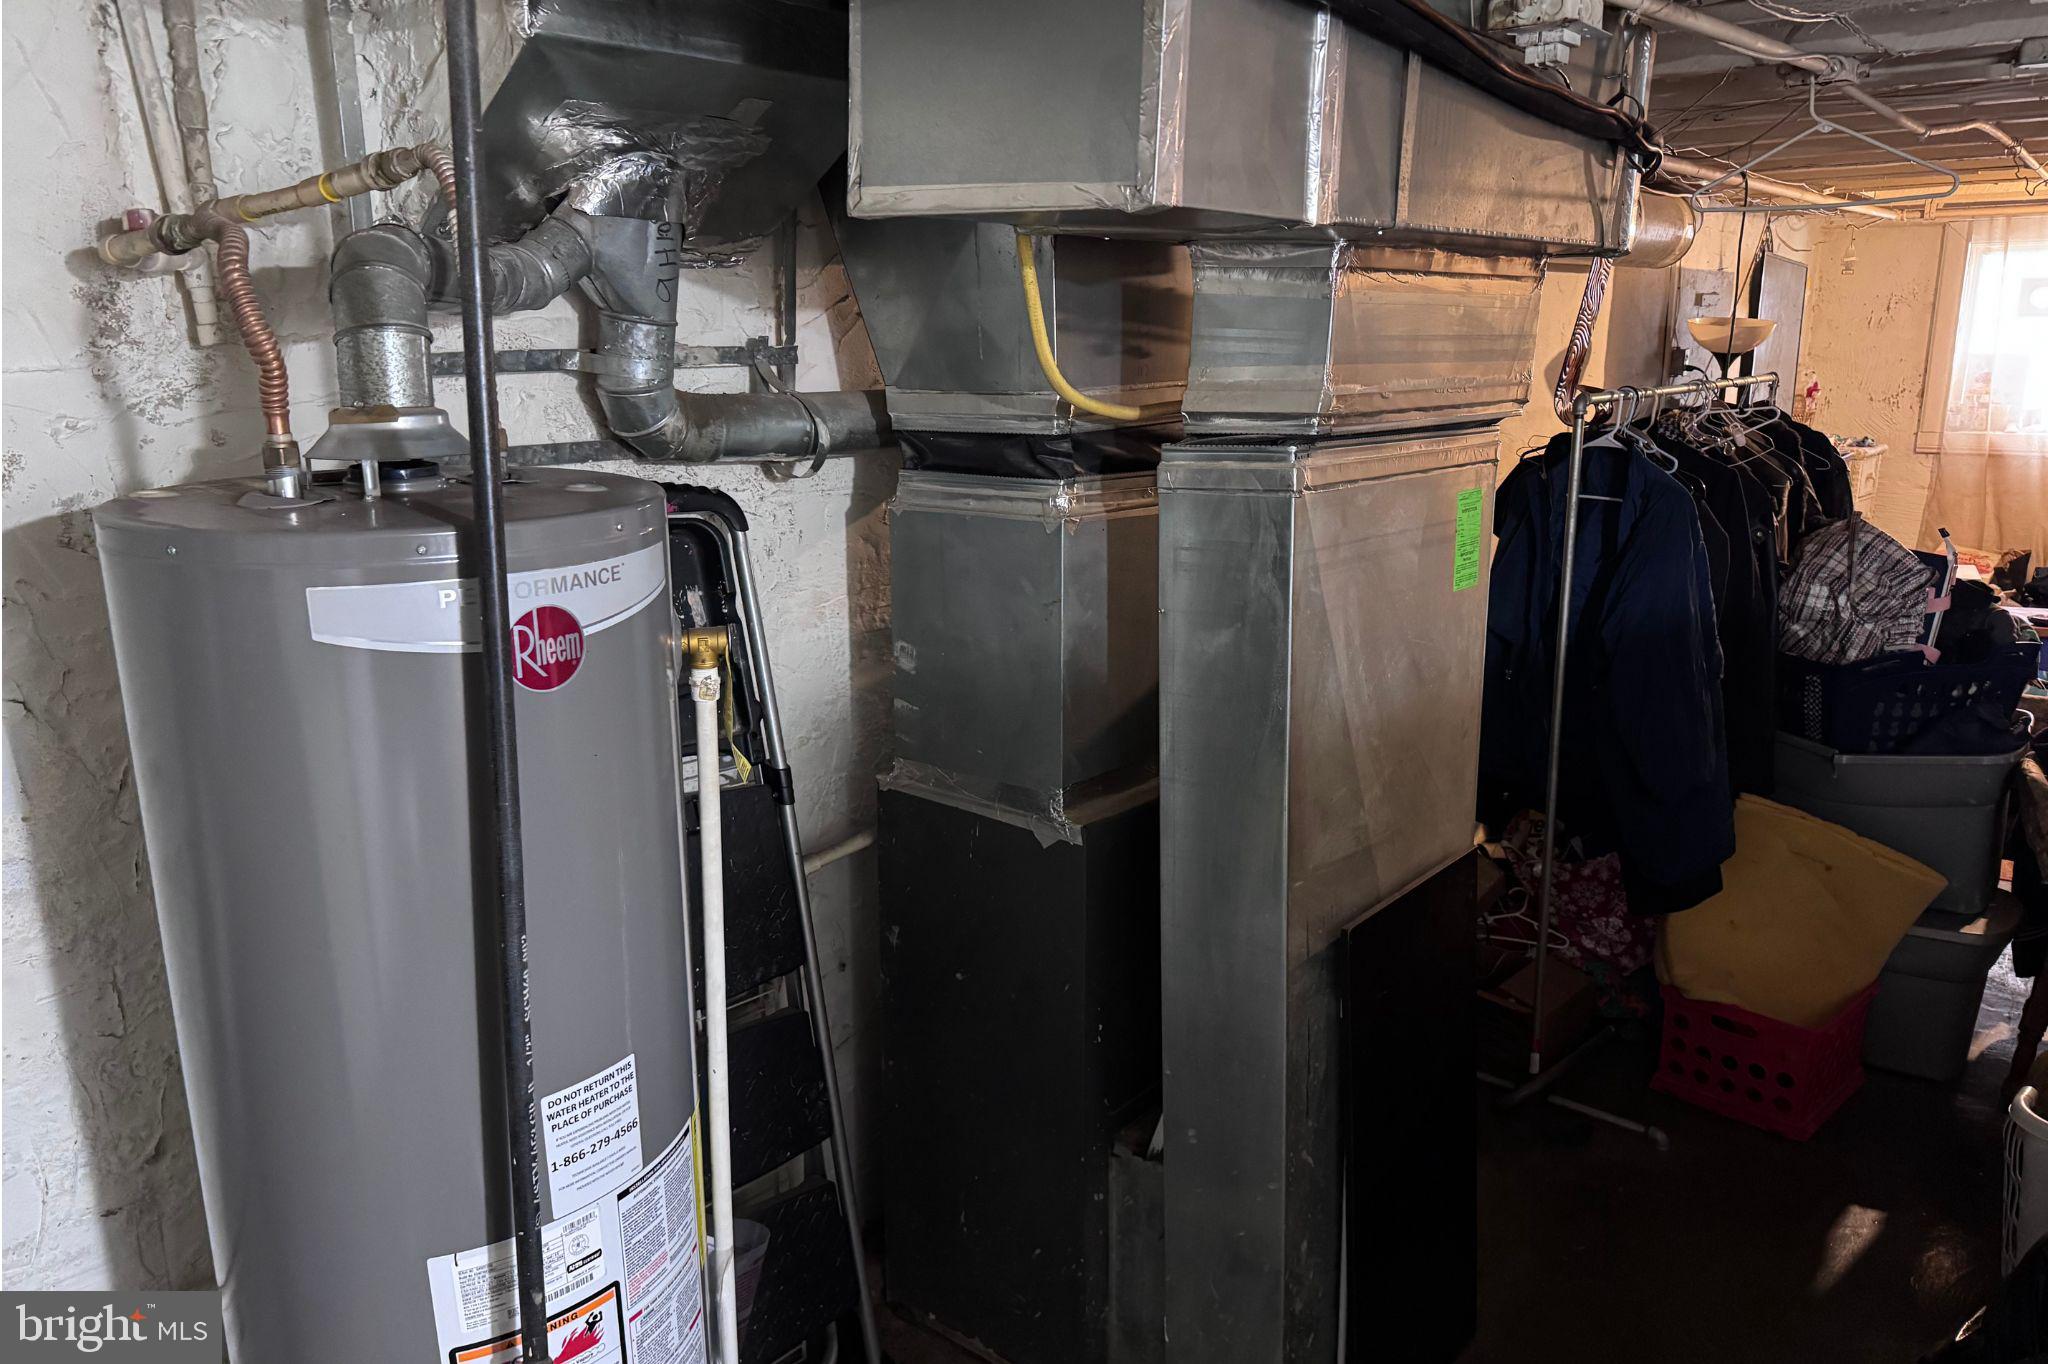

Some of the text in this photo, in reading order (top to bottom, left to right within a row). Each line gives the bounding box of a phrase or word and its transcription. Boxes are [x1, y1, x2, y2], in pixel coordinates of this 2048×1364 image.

[512, 607, 582, 679] Rheem
[546, 1103, 577, 1122] WATER
[578, 1087, 609, 1109] HEATER
[610, 1081, 620, 1092] TO
[621, 1071, 635, 1085] THE
[547, 1061, 632, 1110] DO NOT RETURN THIS
[551, 1115, 580, 1133] PLACE
[580, 1108, 592, 1119] OF
[593, 1084, 633, 1113] PURCHASE
[551, 1117, 638, 1173] 1-866-279-4566
[547, 1311, 579, 1332] NING
